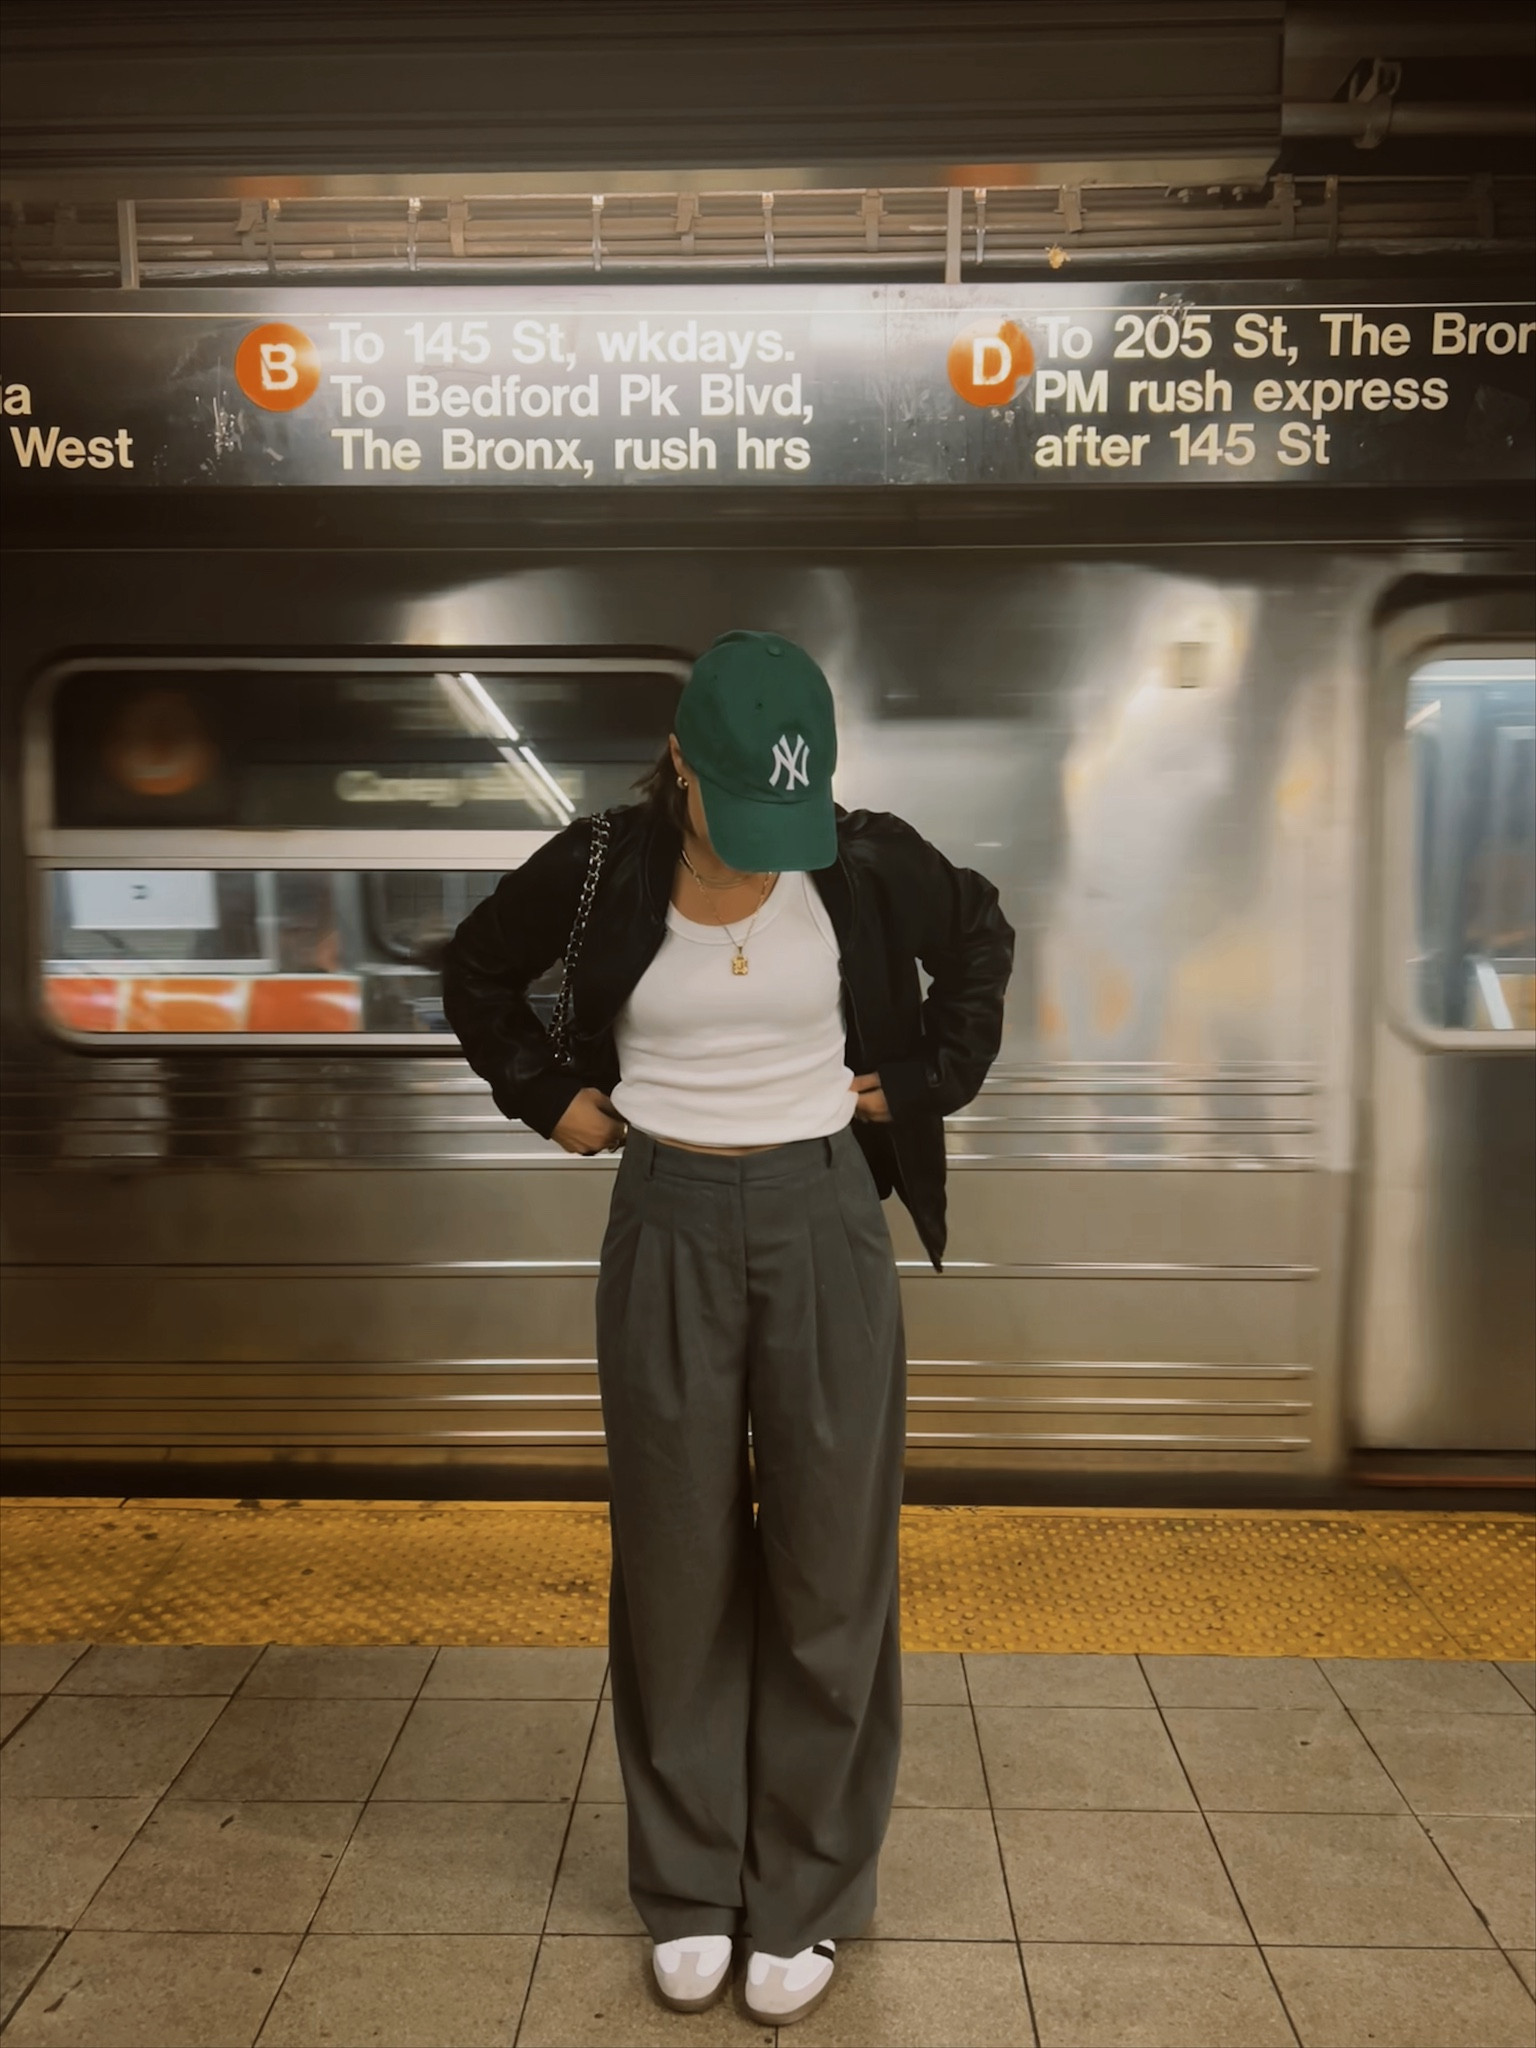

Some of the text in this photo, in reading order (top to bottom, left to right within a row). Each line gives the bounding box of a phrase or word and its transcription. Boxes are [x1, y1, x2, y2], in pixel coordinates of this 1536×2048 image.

[329, 320, 796, 372] To 145 St, wkdays.
[972, 338, 1011, 385] D
[1037, 316, 1093, 360] To
[1114, 314, 1212, 359] 205
[1233, 313, 1299, 366] St,
[1320, 312, 1412, 356] The
[260, 343, 298, 390] B
[330, 373, 814, 424] To Bedford Pk Blvd,
[1036, 369, 1449, 419] PM rush express
[10, 426, 134, 468] West
[331, 427, 811, 478] The Bronx, rush hrs
[1035, 422, 1330, 467] after 145 St
[769, 734, 810, 790] NY
